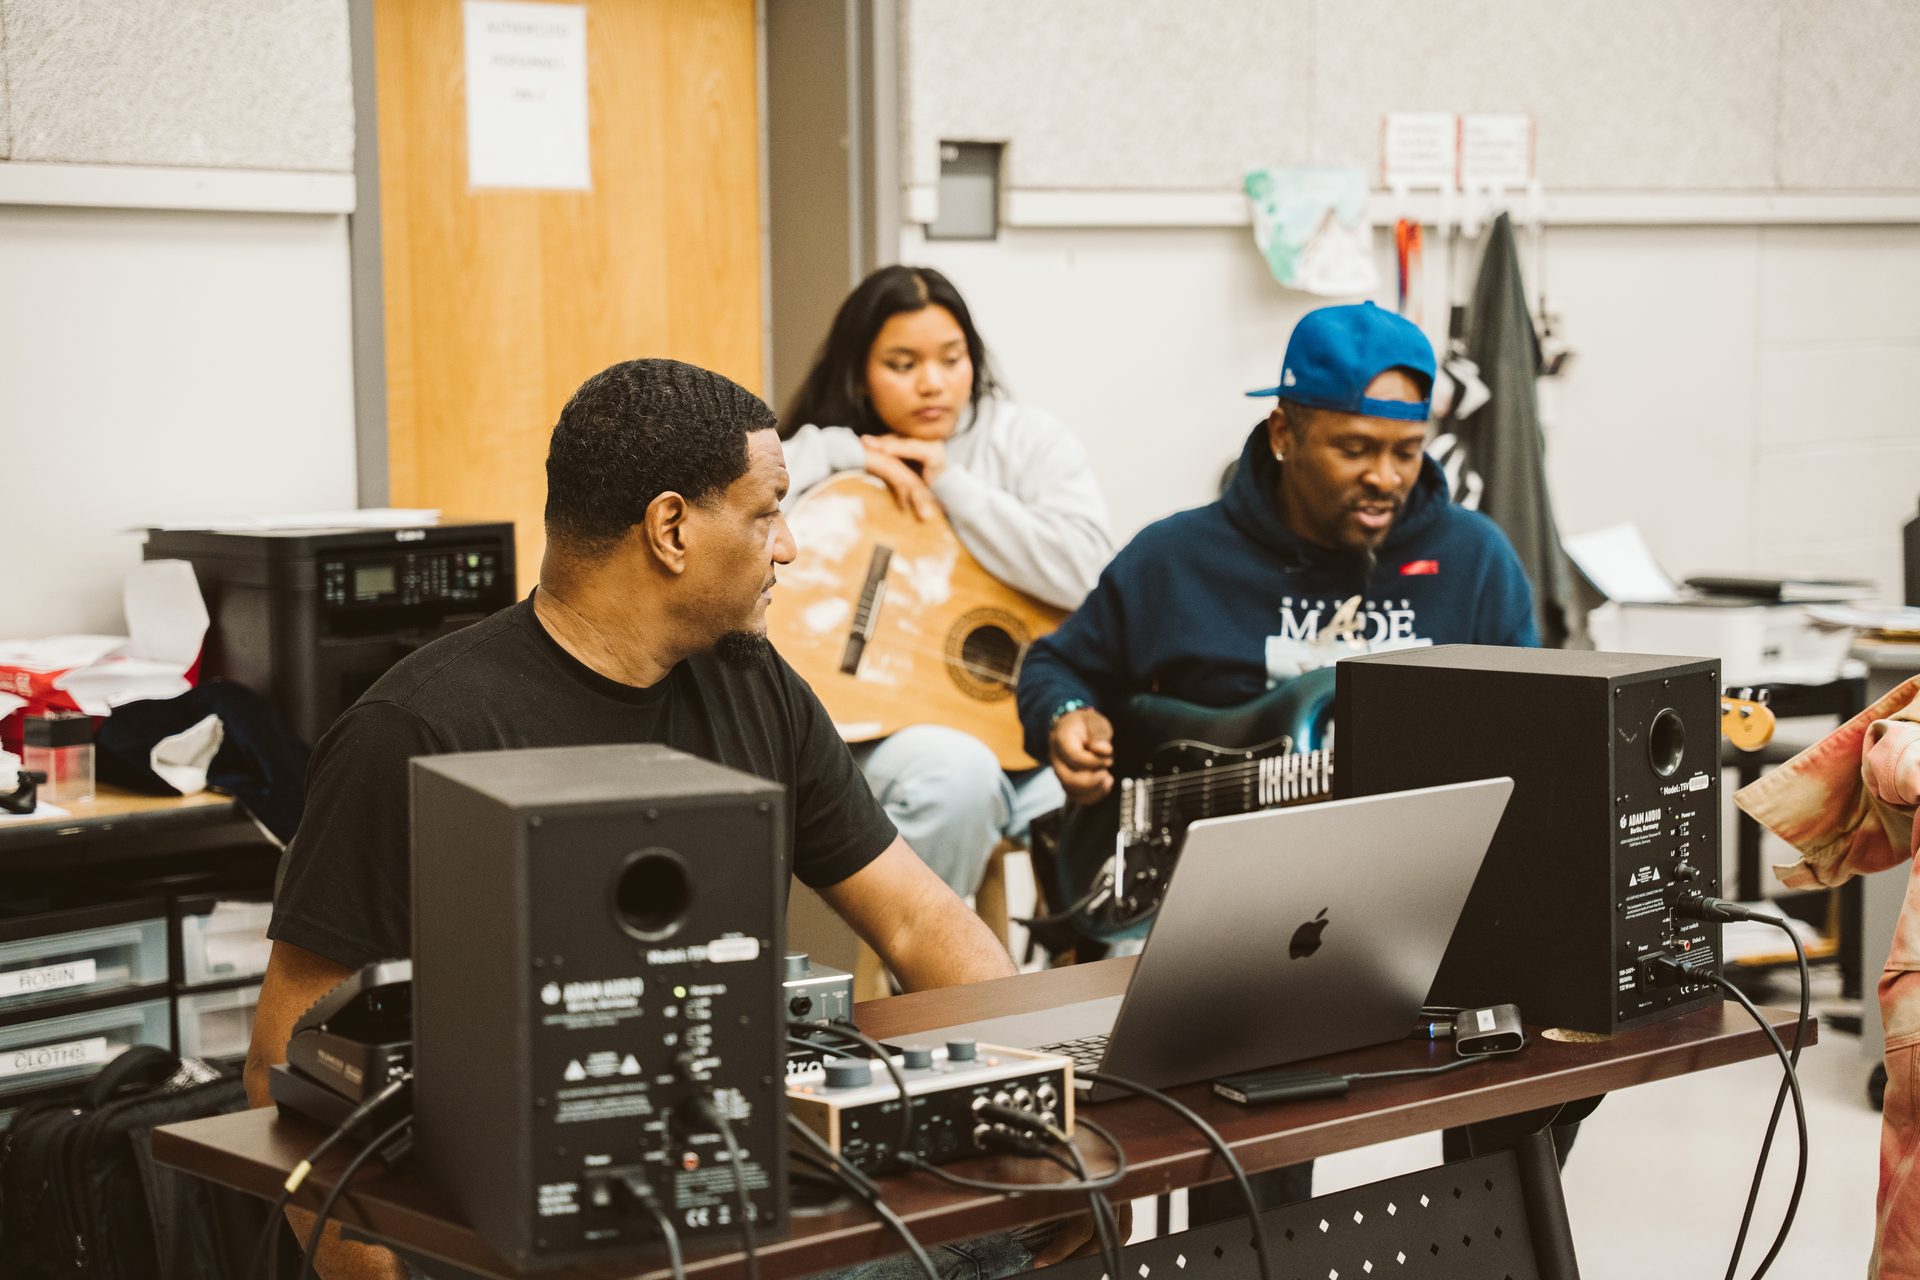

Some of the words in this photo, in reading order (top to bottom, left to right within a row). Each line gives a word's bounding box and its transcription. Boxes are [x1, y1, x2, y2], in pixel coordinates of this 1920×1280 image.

[1629, 812, 1644, 827] ADAM
[1645, 808, 1661, 824] AUDIO
[19, 968, 76, 990] ROSIN
[14, 1043, 86, 1070] CLOTHS
